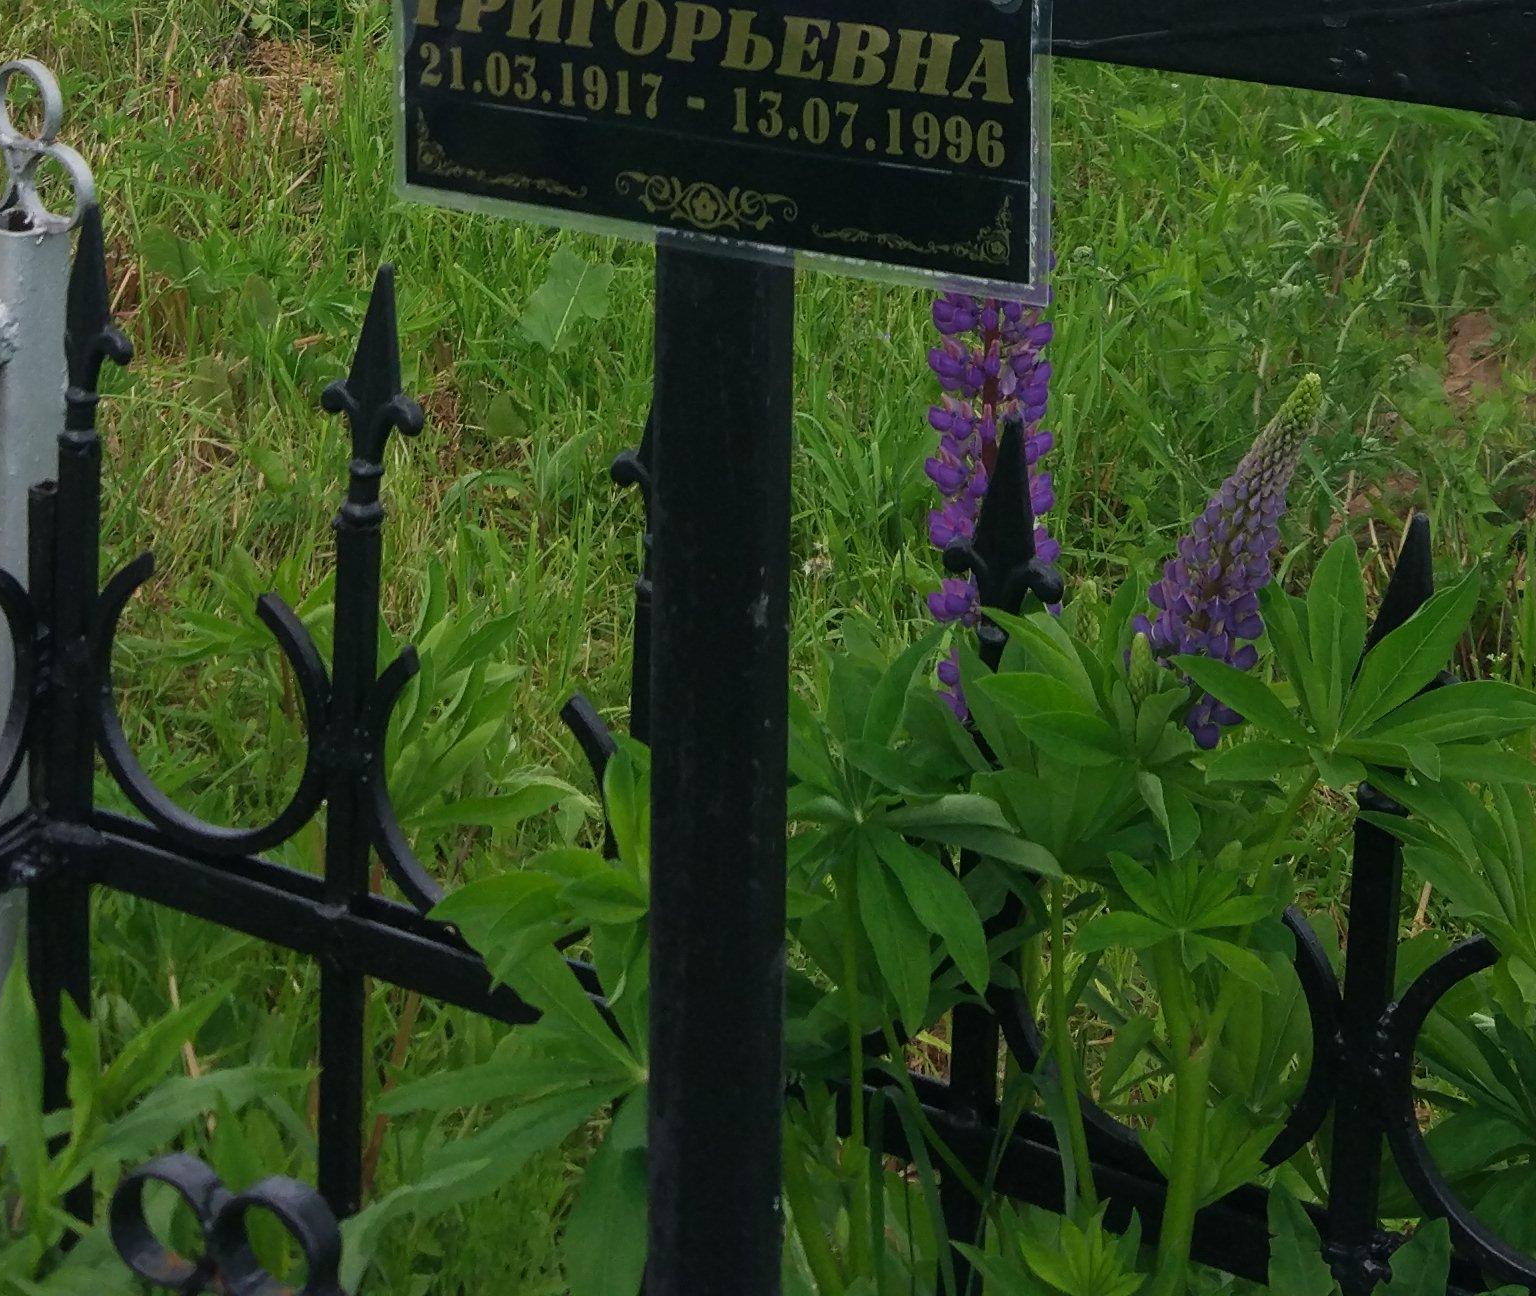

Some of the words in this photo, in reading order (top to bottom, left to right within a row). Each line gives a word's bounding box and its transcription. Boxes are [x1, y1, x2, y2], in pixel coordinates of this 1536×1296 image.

[419, 43, 663, 119] 21.03.1917
[686, 97, 706, 110] -
[732, 85, 1006, 168] 13.07.1996
